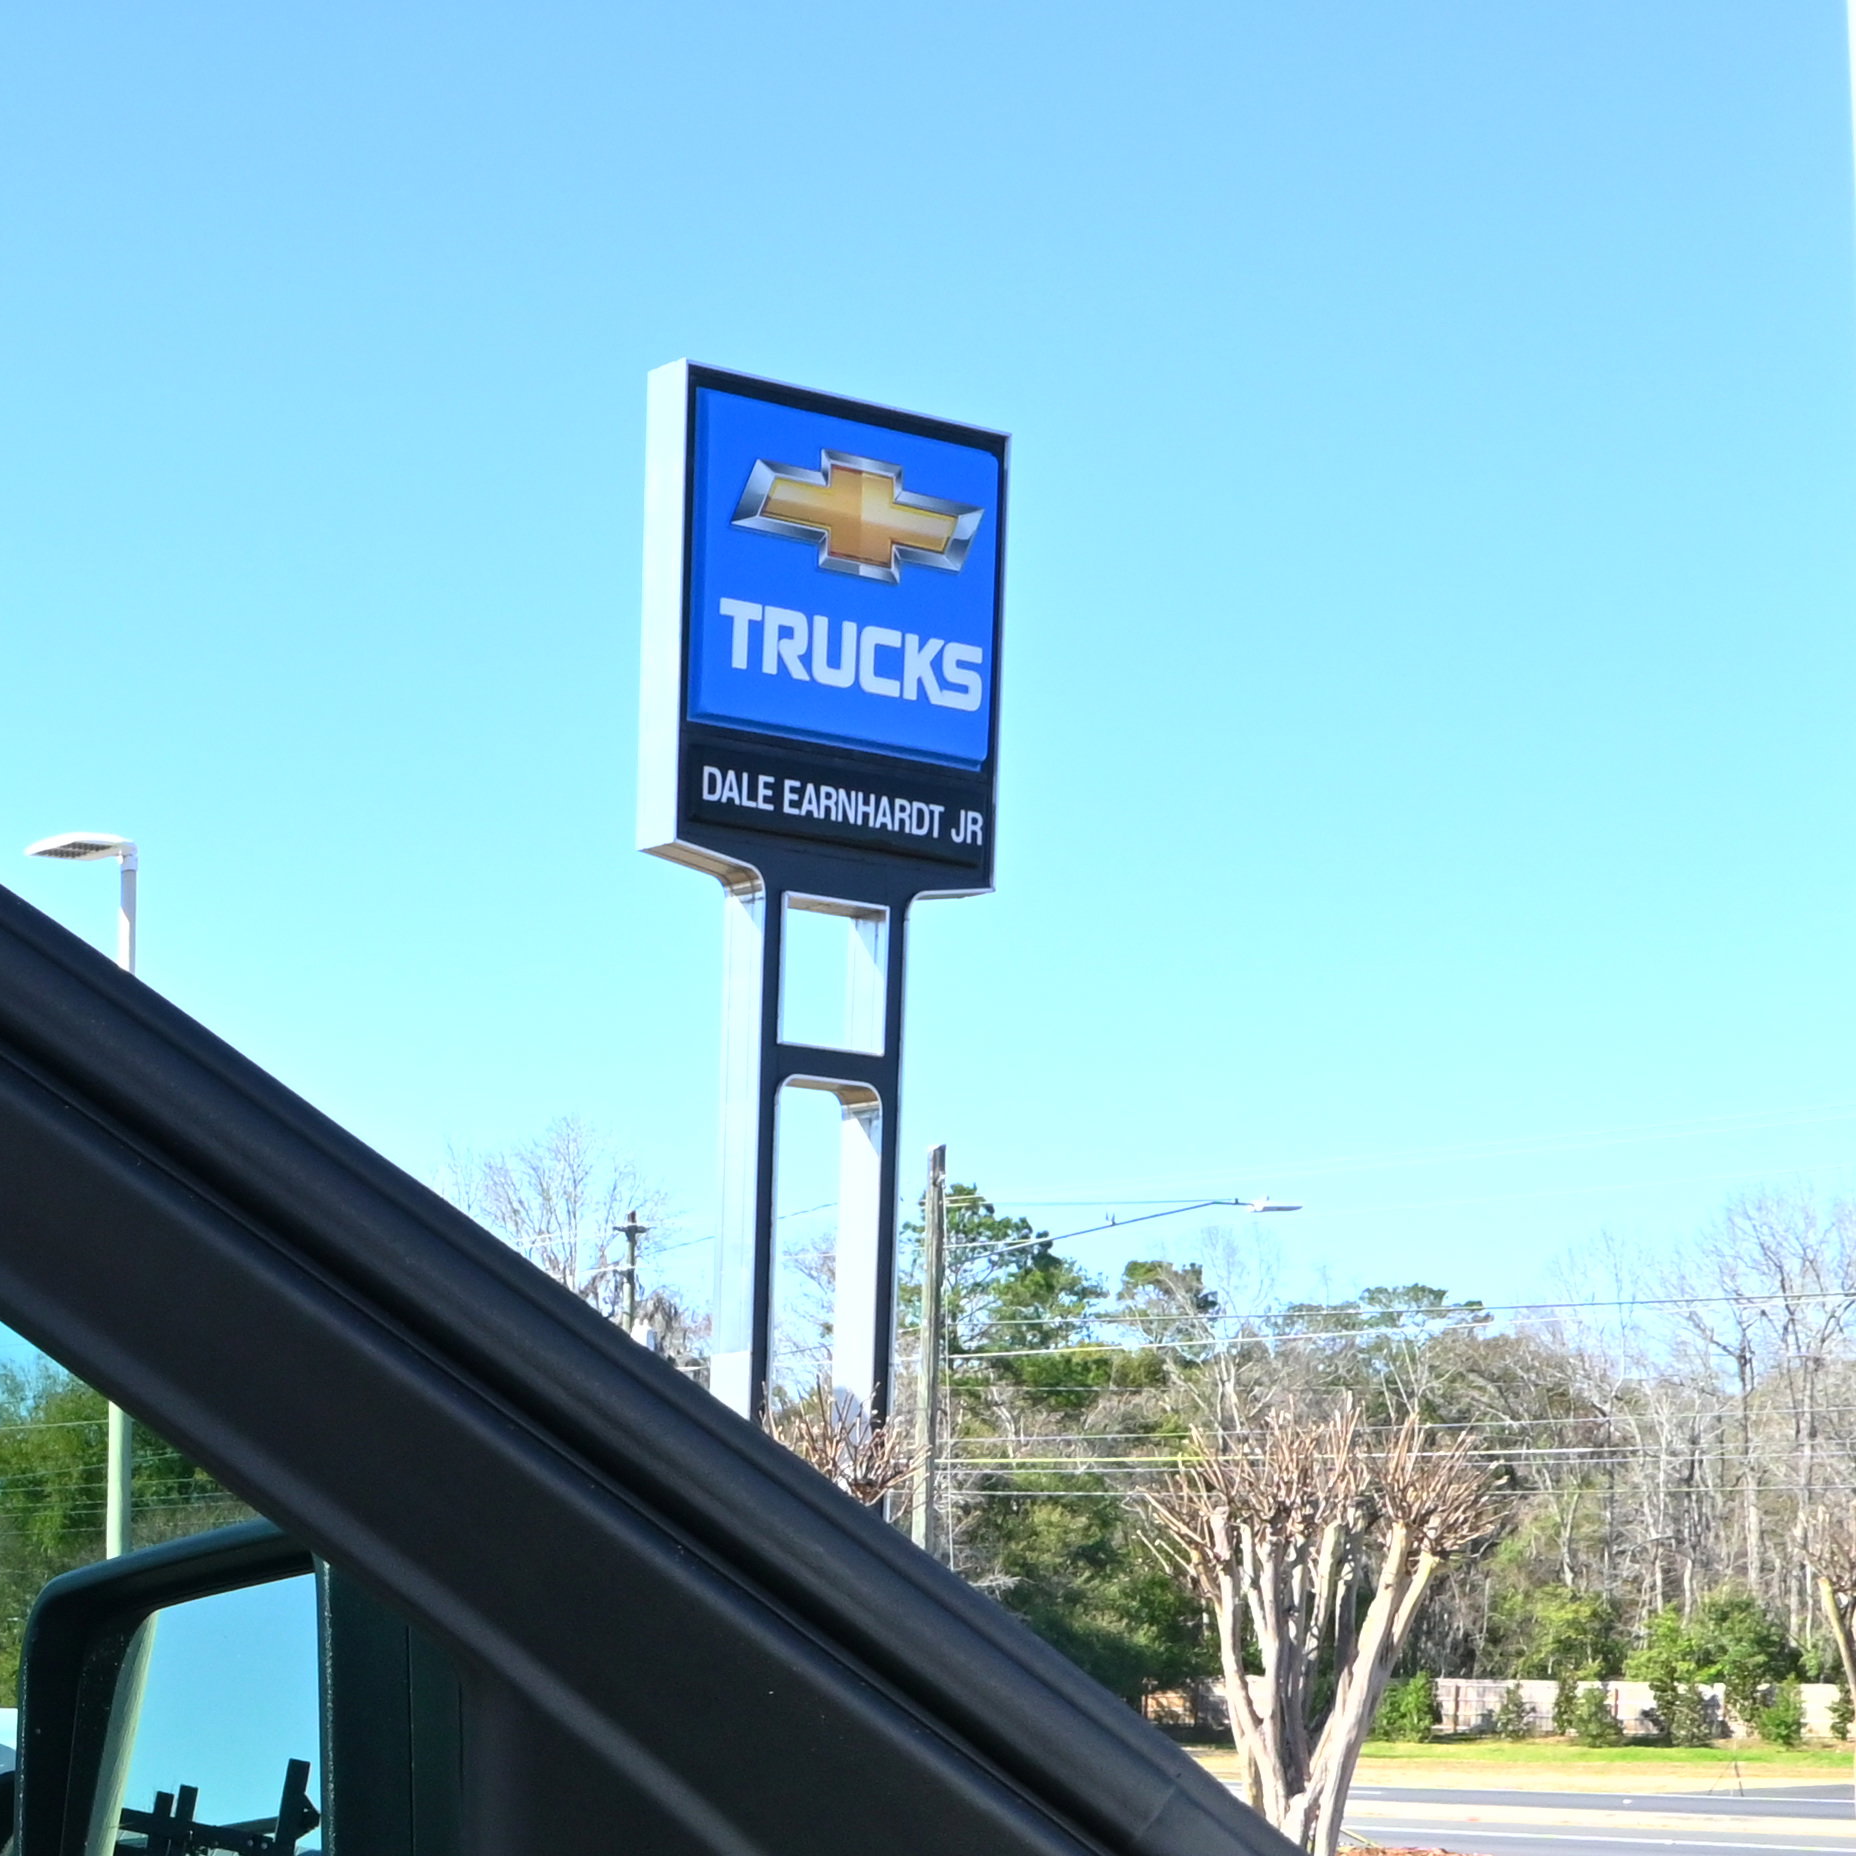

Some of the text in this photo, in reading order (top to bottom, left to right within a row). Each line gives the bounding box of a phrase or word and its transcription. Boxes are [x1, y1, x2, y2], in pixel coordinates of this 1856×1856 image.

[719, 596, 983, 712] TRUCKS
[702, 765, 984, 846] DALE EARNHARDT JR
